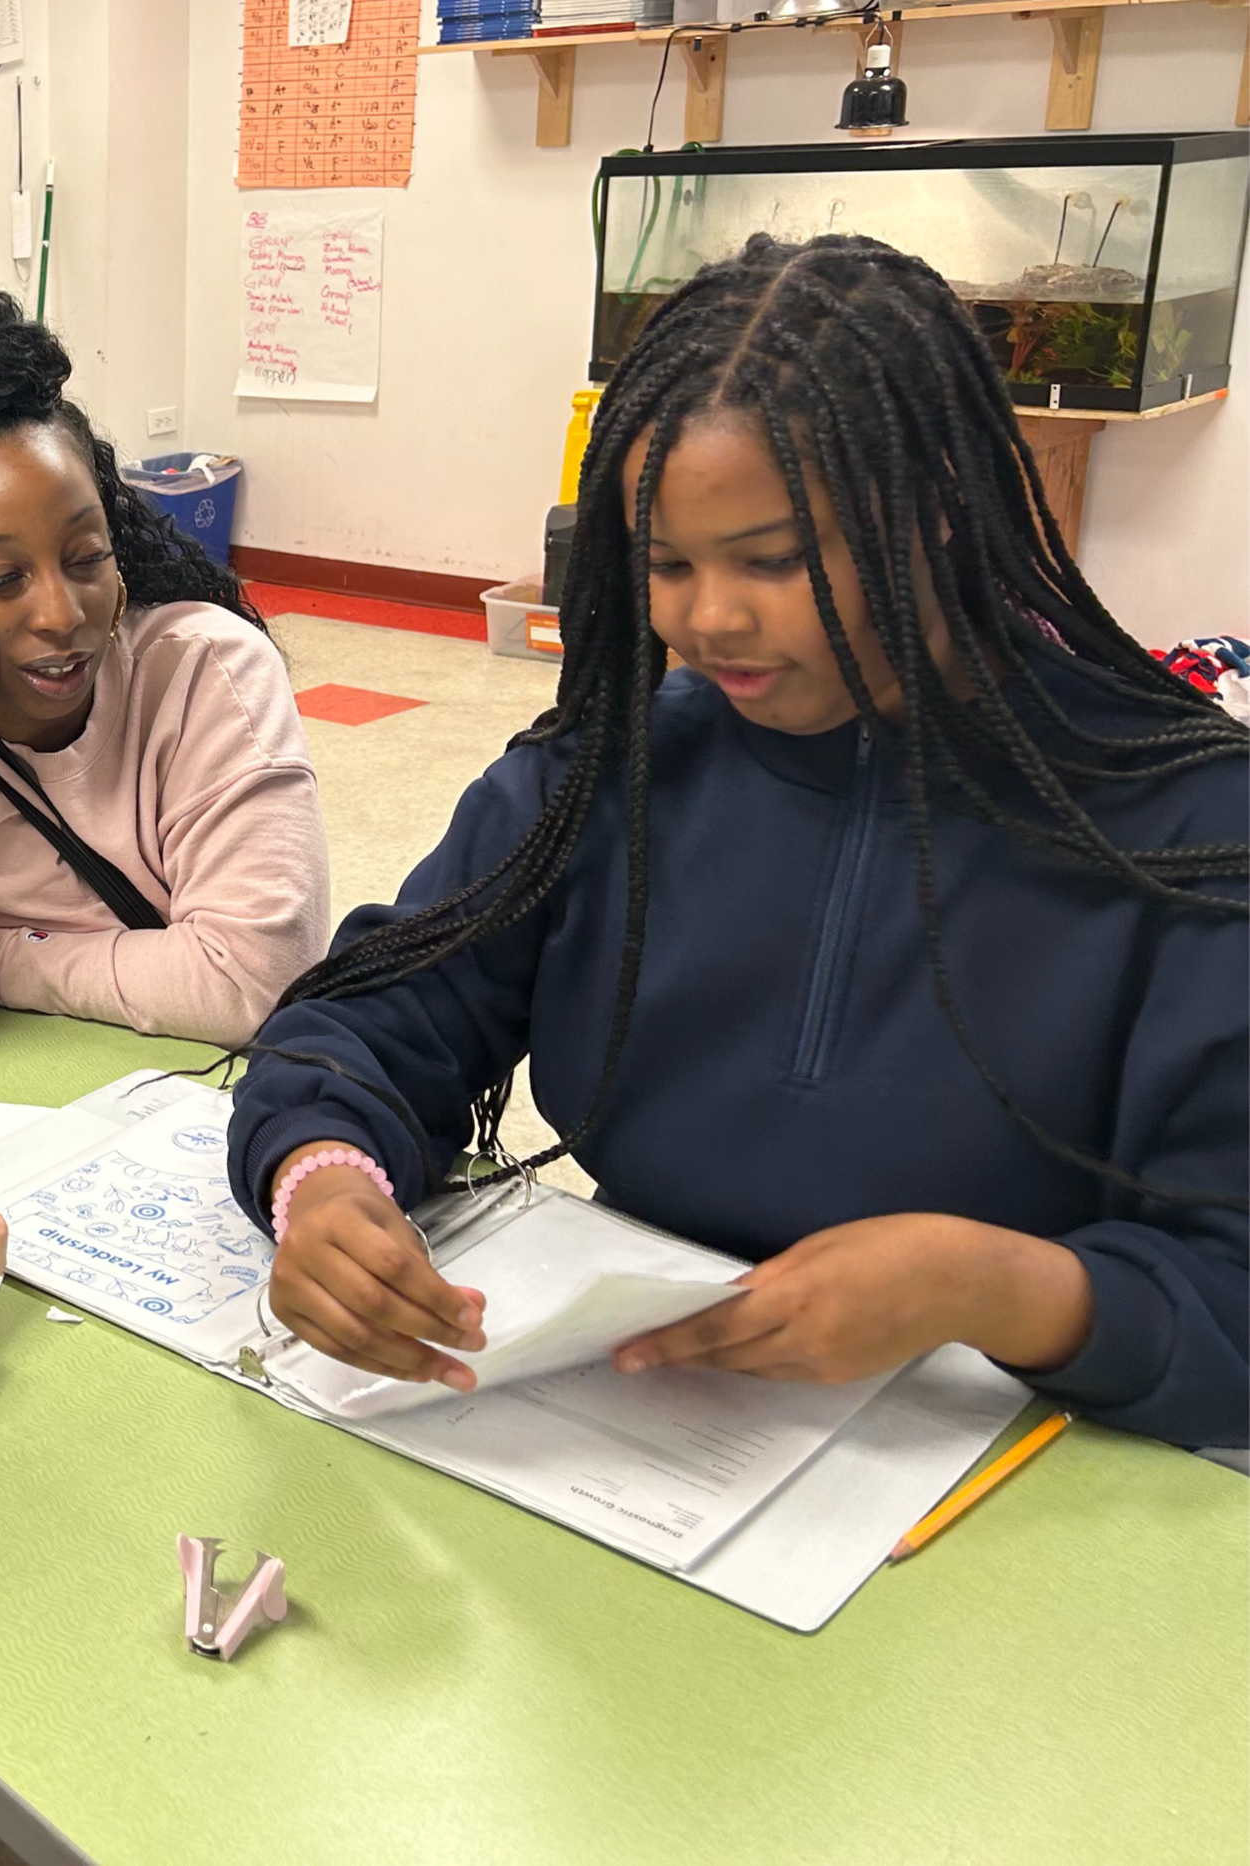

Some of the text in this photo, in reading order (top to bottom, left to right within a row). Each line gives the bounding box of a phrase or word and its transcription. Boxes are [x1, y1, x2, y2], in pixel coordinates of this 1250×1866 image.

[38, 1227, 181, 1286] My Leadership
[570, 1484, 616, 1510] Growth
[616, 1506, 684, 1539] Diagnostic
